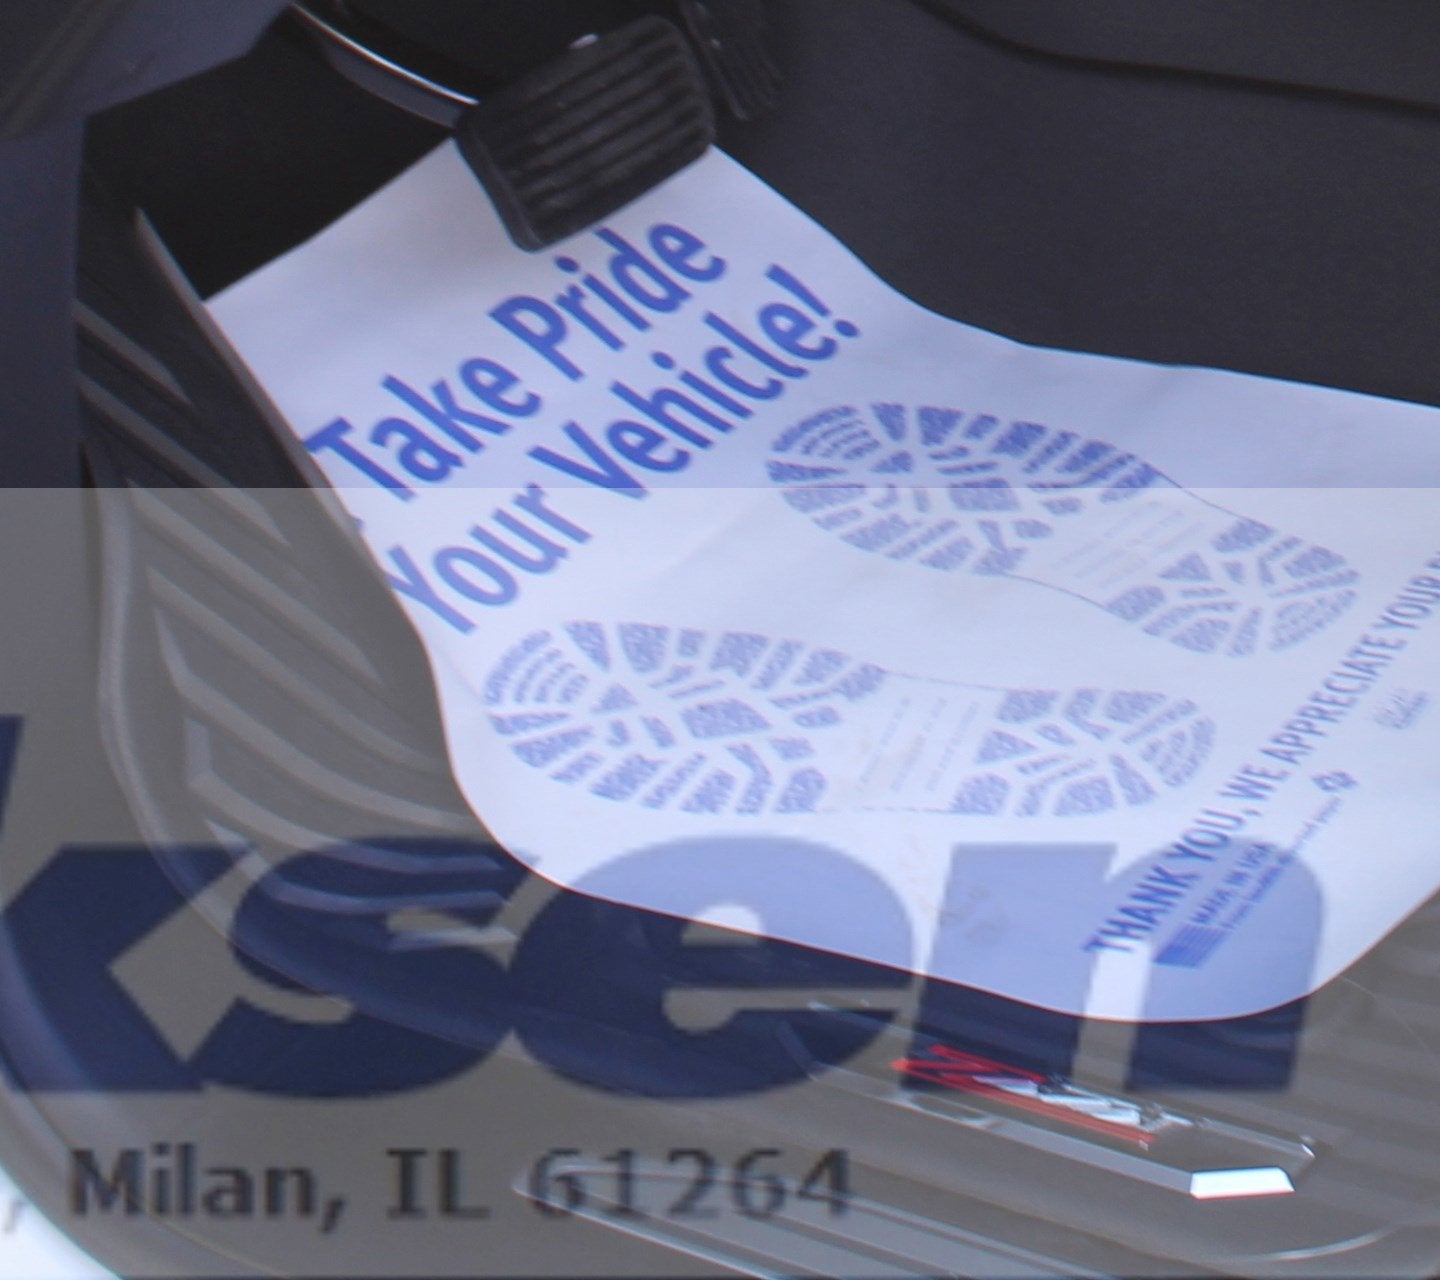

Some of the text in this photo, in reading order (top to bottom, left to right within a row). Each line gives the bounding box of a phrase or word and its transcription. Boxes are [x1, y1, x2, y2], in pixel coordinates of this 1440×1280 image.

[306, 223, 727, 502] Take Pride
[386, 263, 860, 635] Your Vehicle!
[1081, 864, 1201, 953] THANK
[1163, 806, 1263, 862] YOU,
[1216, 764, 1291, 801] WE
[1260, 634, 1408, 766] APPRECIATE
